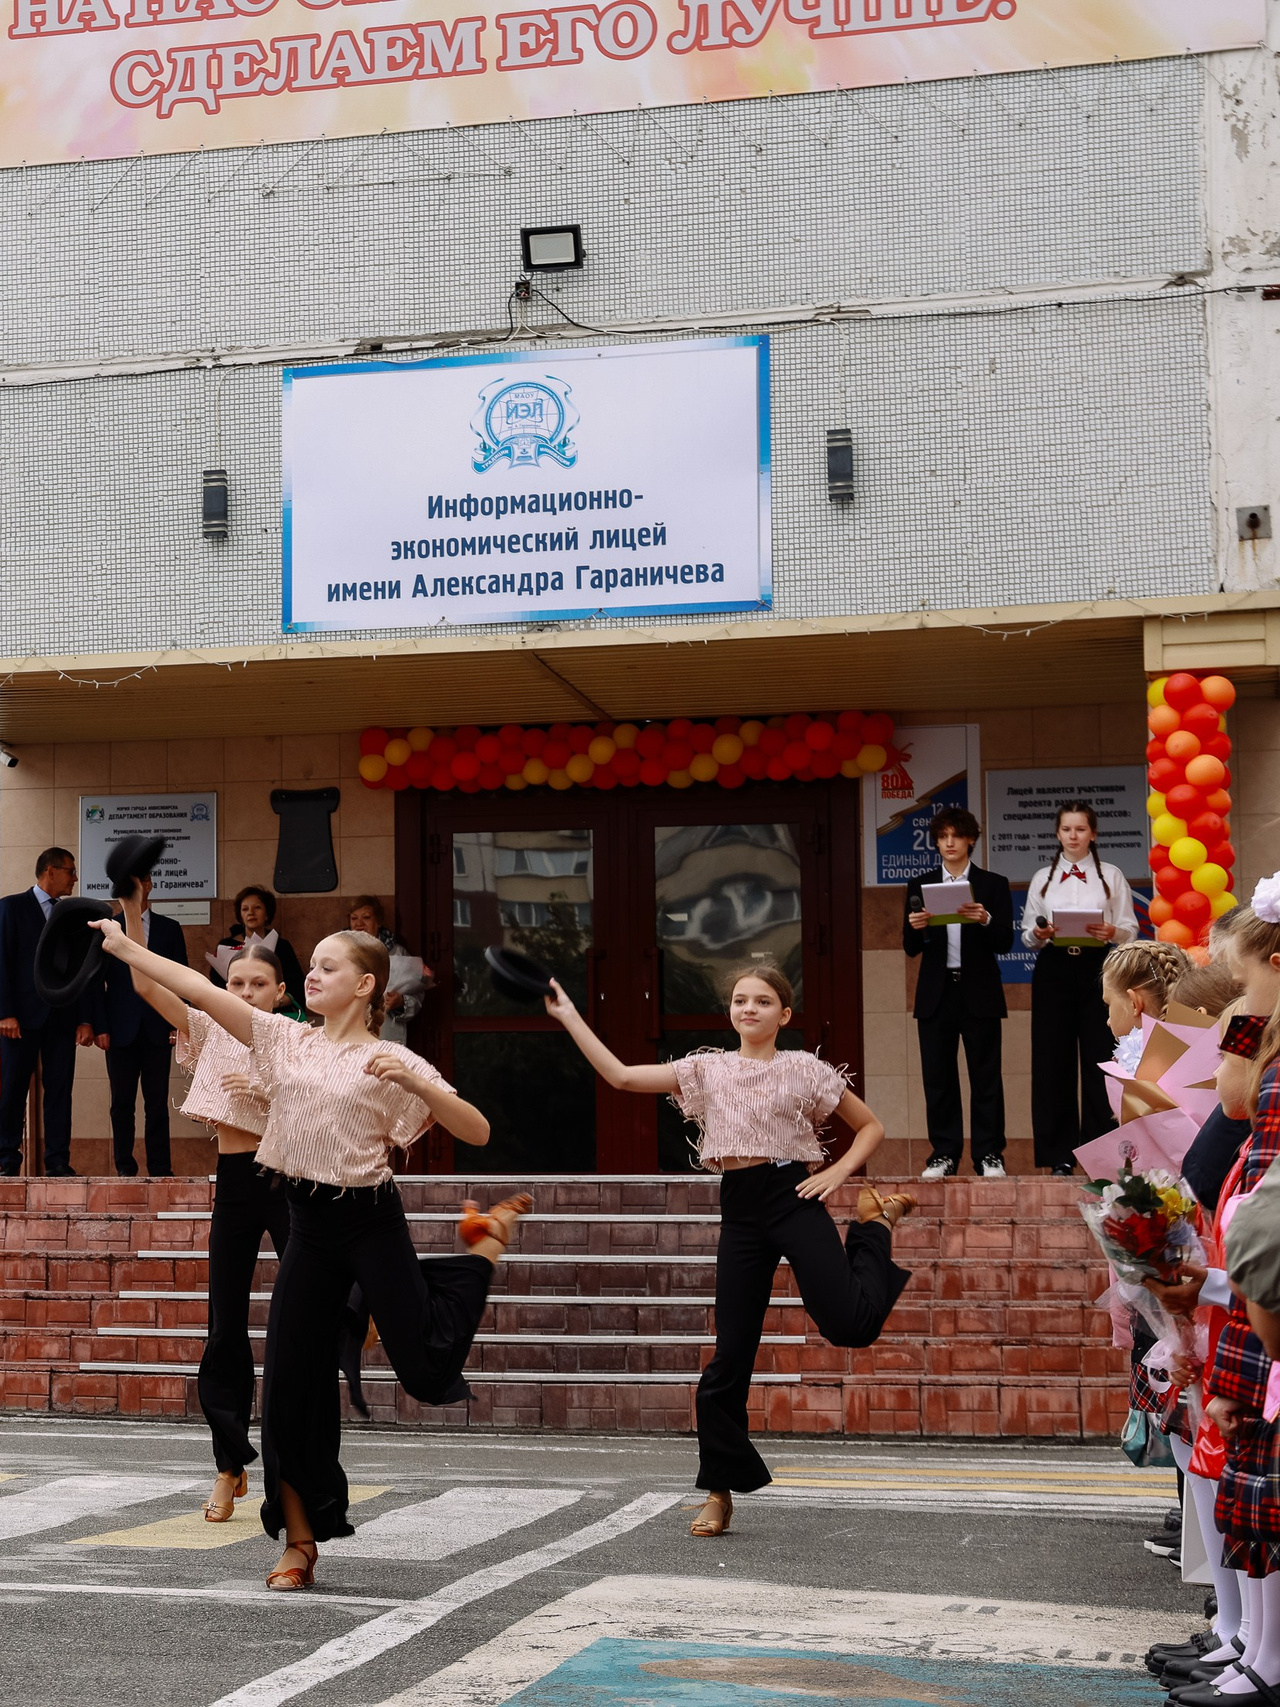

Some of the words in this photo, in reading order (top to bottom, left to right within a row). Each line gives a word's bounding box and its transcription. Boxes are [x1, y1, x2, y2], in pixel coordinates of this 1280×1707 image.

[110, 16, 486, 119] СДЕЛАЕМ
[496, 0, 657, 71] ЕГО
[427, 488, 644, 521] Информационно-
[390, 526, 579, 560] экономический
[589, 521, 668, 550] лицей
[326, 578, 401, 602] имени
[411, 566, 564, 598] Александра
[575, 561, 725, 592] Гараничева
[881, 774, 899, 789] 80
[881, 789, 914, 799] ПОБЕДА!
[1007, 786, 1033, 796] Лицей
[1018, 800, 1052, 808] проекта
[1095, 797, 1115, 806] сети
[149, 811, 188, 819] ОБРАЗОВАНИЯ
[1014, 833, 1030, 841] года
[1014, 844, 1030, 852] года
[882, 852, 930, 867] ЕДИНЫЙ
[165, 868, 188, 877] лицей
[87, 882, 109, 890] имени
